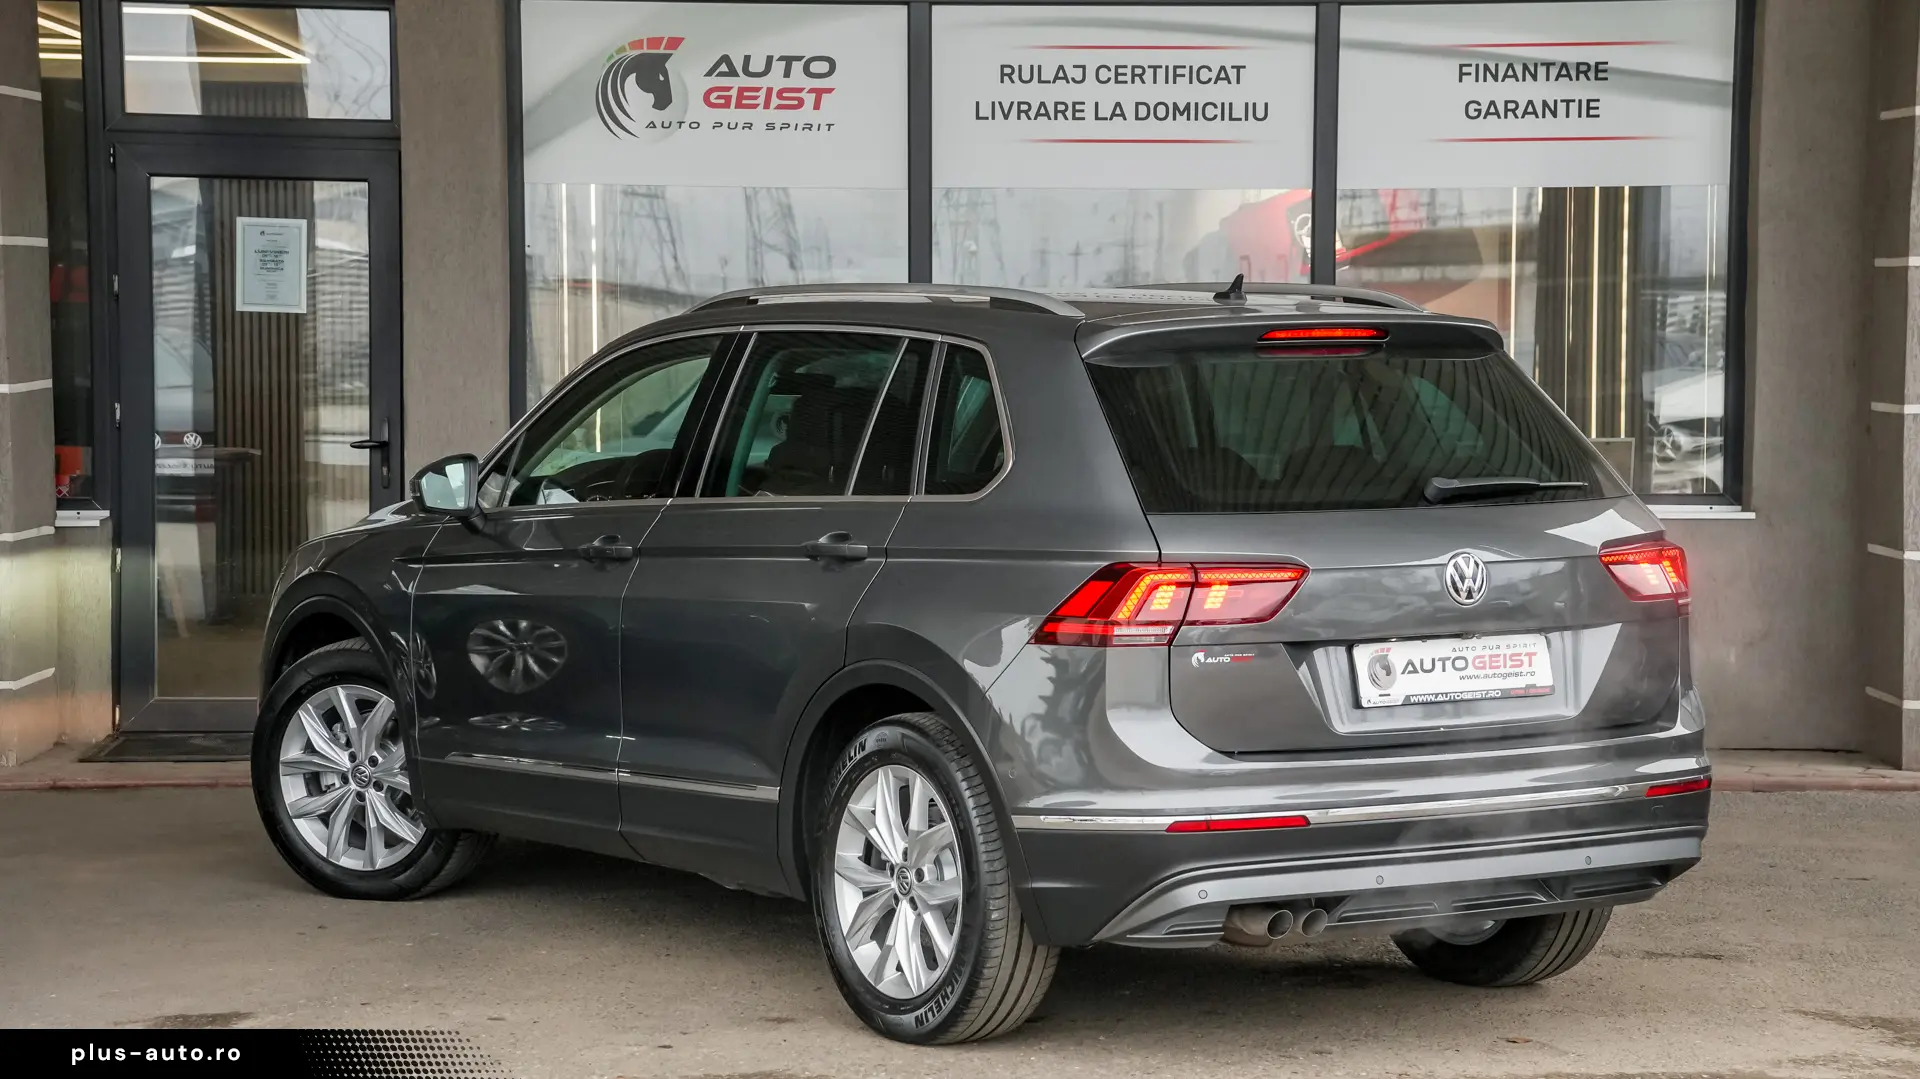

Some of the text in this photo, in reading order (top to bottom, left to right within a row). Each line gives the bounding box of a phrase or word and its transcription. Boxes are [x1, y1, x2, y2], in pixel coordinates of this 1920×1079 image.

[703, 53, 837, 79] AUTO
[999, 64, 1247, 85] RULAJ CERTIFICAT
[1458, 61, 1609, 83] FINANTARE
[702, 86, 836, 111] GEIST
[1464, 98, 1601, 120] GARANTIE
[975, 101, 1269, 122] LIVRARE LA DOMICILIU
[645, 120, 836, 132] AUTO PUR SPIRIT
[1458, 670, 1536, 681] www.autogeist.ro
[1409, 689, 1502, 703] WWW.AUTOGEIST.RO
